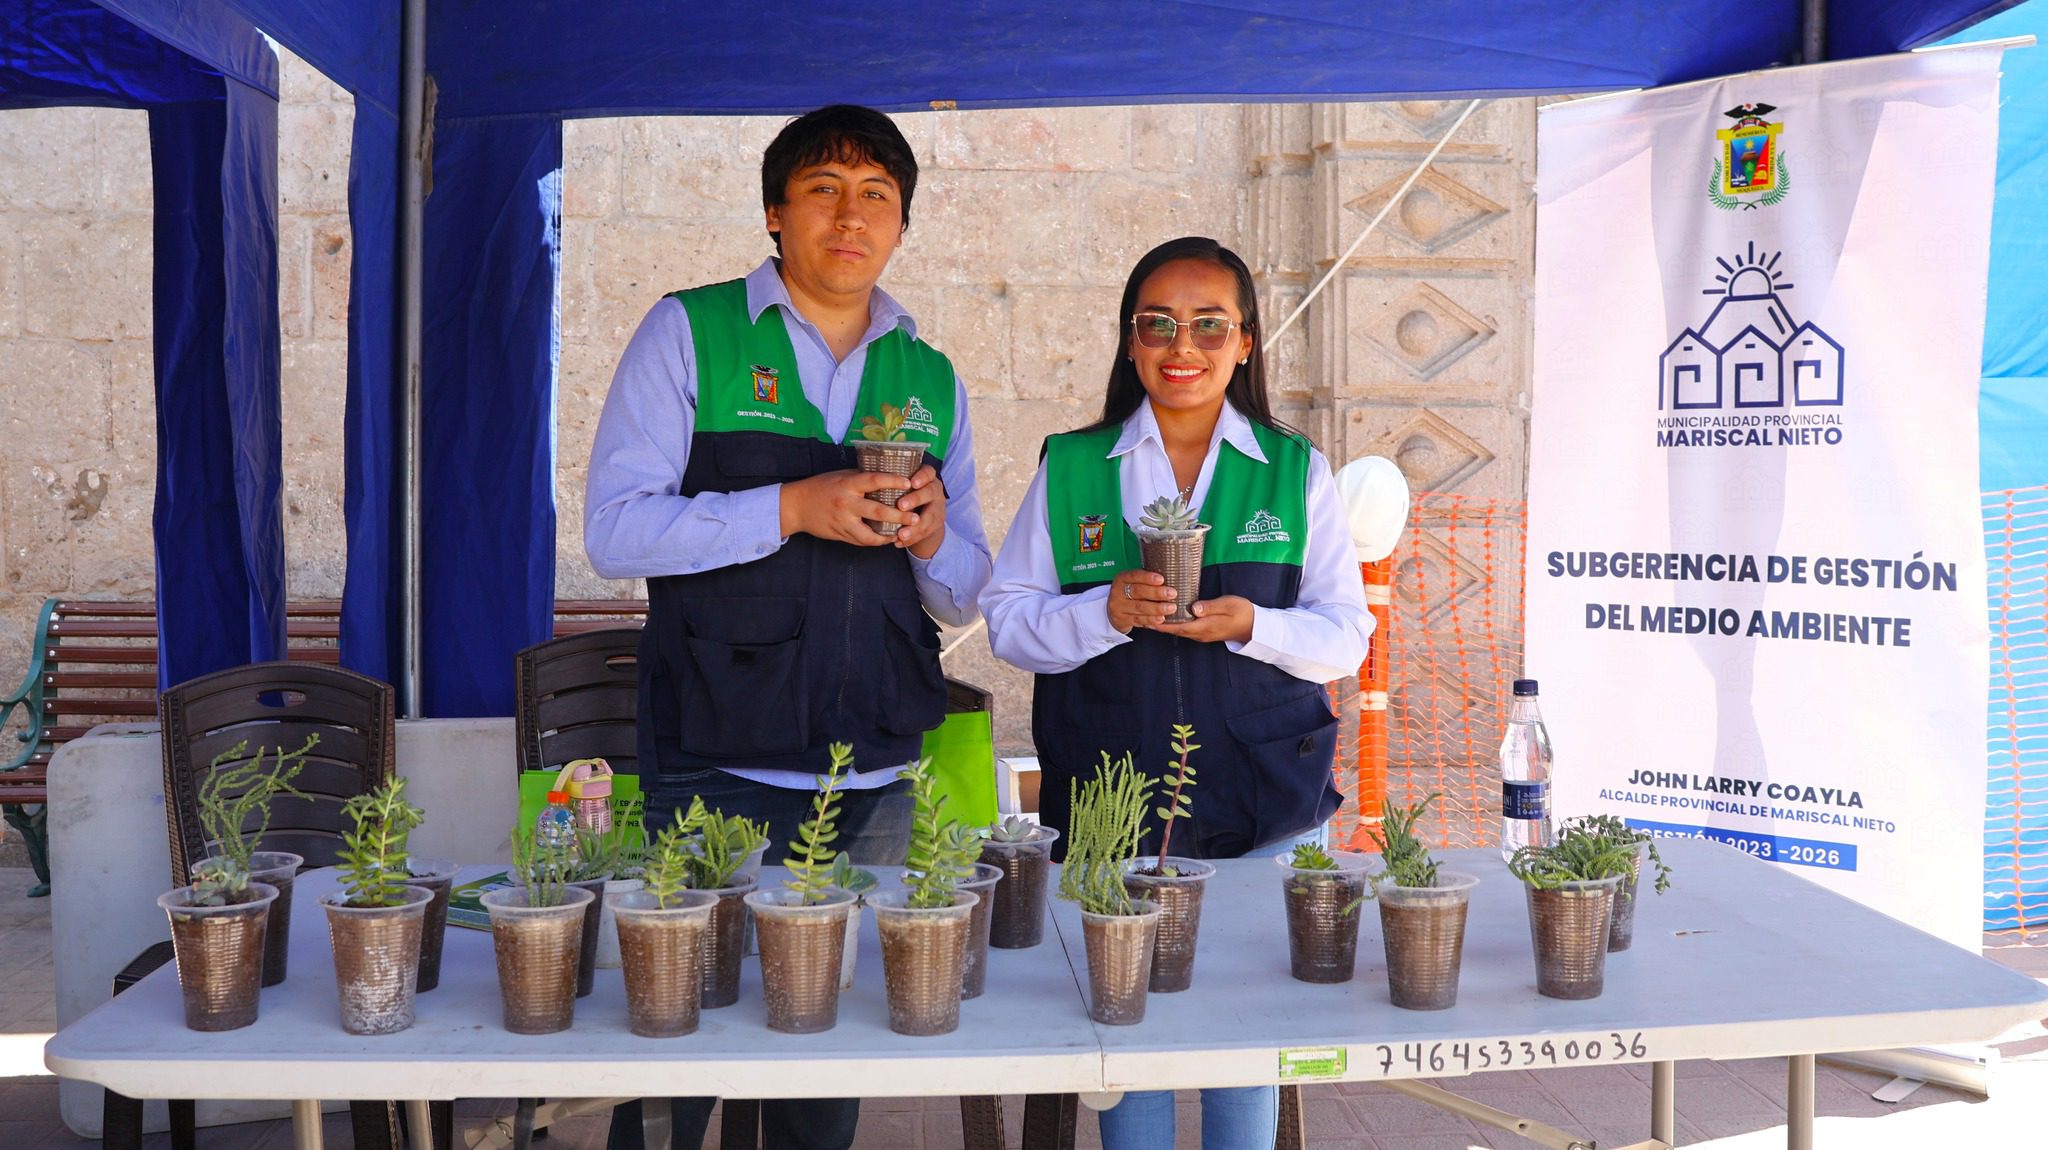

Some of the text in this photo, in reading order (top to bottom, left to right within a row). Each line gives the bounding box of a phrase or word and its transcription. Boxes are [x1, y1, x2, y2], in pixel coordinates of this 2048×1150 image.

[1657, 414, 1843, 429] MUNICIPALIDAD PROVINCIAL
[1657, 427, 1843, 447] MARISCAL NIETO
[1547, 550, 1958, 592] SUBGERENCIA DE GESTIÓN
[1585, 603, 1912, 648] DEL MEDIO AMBIENTE
[1628, 769, 1864, 809] JOHN LARRY COAYLA
[1599, 788, 1896, 833] ALCALDE PROVINCIAL DE MARISCAL NIETO
[1726, 837, 1772, 857] 2023
[1376, 1032, 1648, 1077] 746453390036
